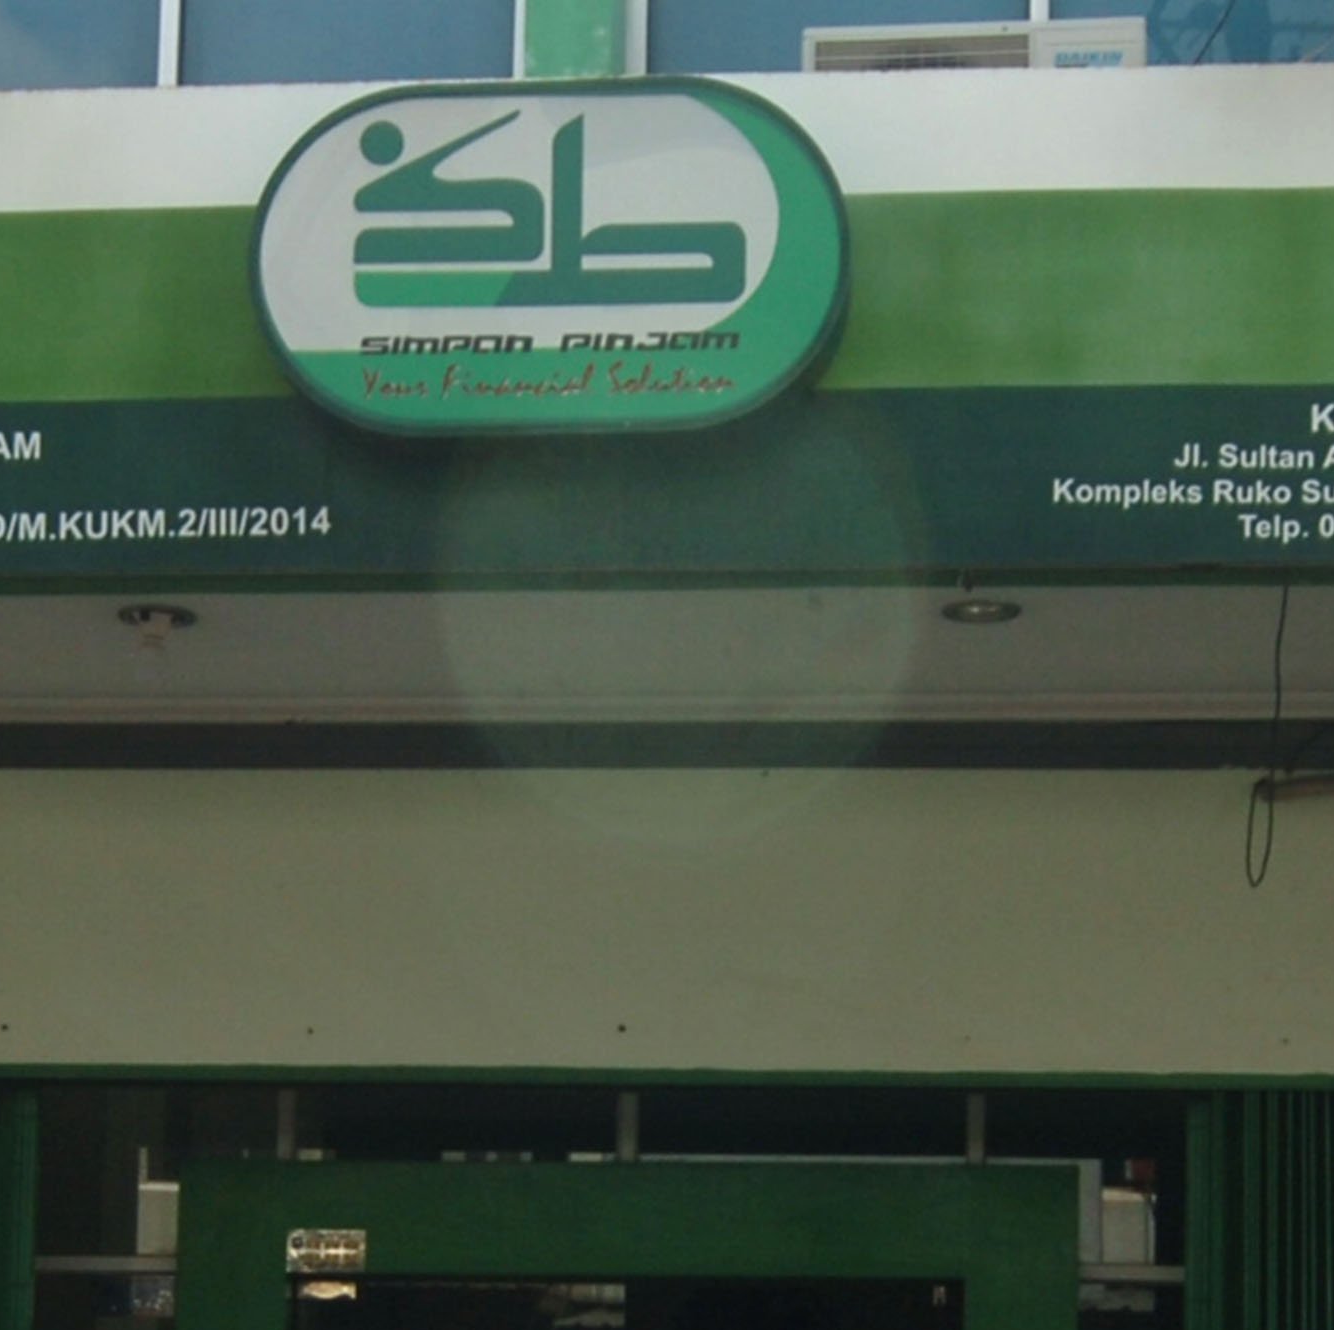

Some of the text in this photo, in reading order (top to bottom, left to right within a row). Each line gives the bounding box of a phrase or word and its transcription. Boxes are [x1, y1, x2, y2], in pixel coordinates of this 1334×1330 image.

[362, 358, 736, 401] Your Financial Solution
[1173, 442, 1209, 469] Jl.
[1218, 442, 1315, 470] Sultan
[1052, 477, 1203, 510] Kompleks
[1212, 479, 1293, 505] Ruko
[1238, 512, 1309, 545] Telp.
